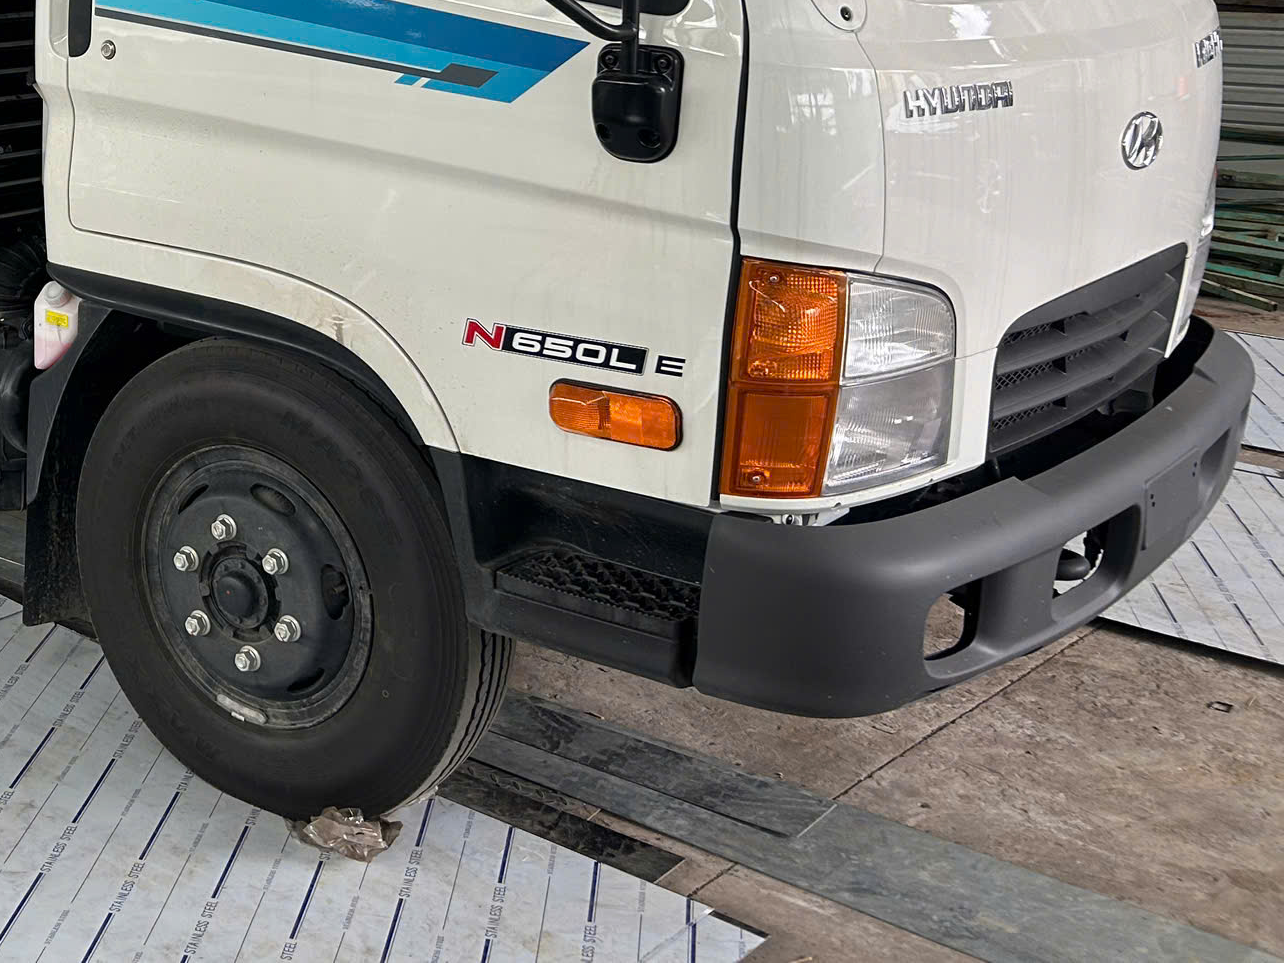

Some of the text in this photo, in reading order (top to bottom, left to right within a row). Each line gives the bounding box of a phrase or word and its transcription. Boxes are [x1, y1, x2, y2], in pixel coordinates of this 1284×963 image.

[904, 80, 1013, 118] HYUNDAI
[655, 355, 686, 377] E
[176, 769, 194, 793] STAINLE
[244, 805, 261, 827] STAIN
[40, 825, 77, 872] STAINLESS STEEL
[109, 862, 145, 912] STAINLESS STEEL
[398, 849, 423, 898] STAINLESS STEEL
[184, 901, 218, 954] STAINLESS STEEL
[484, 886, 506, 938] STAINLESS STEEL
[280, 942, 296, 960] STEEL
[583, 925, 596, 943] STEEL
